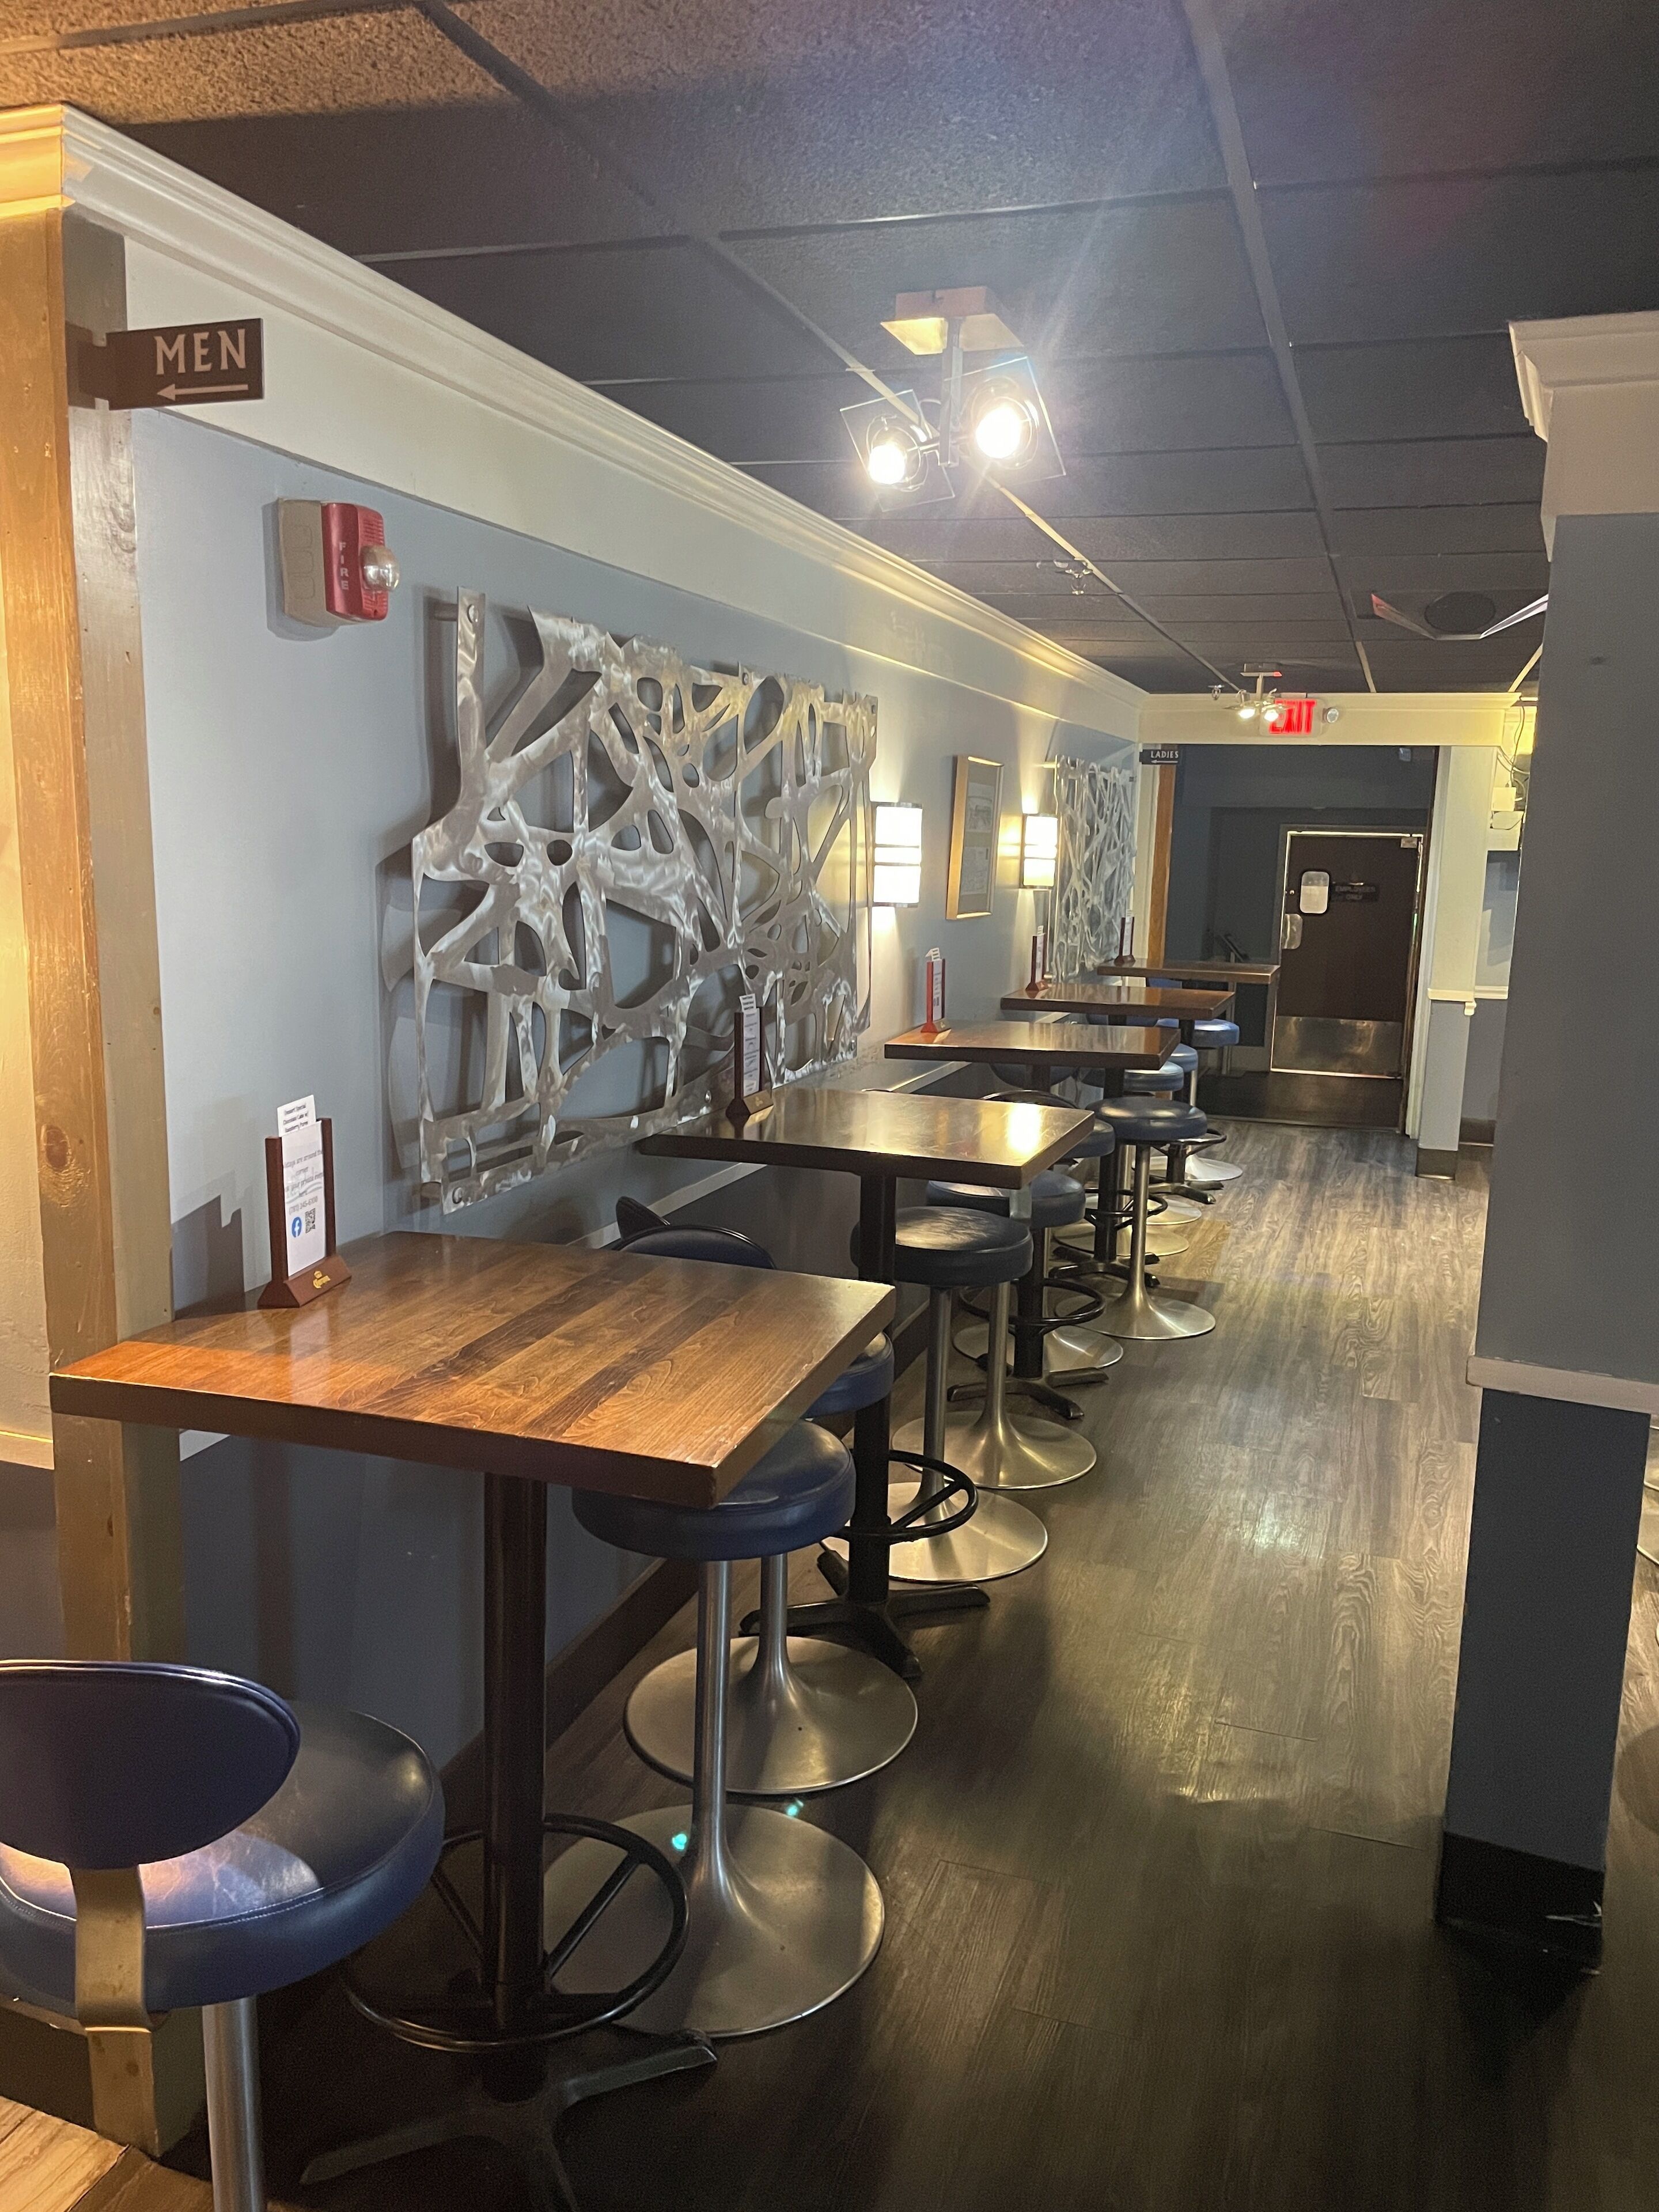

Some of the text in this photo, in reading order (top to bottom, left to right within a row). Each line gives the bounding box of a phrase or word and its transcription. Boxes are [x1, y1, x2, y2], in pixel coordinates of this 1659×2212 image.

[154, 329, 247, 375] MEN
[339, 541, 349, 590] FIRE
[1269, 699, 1317, 734] EXIT
[1150, 751, 1179, 759] LADIES
